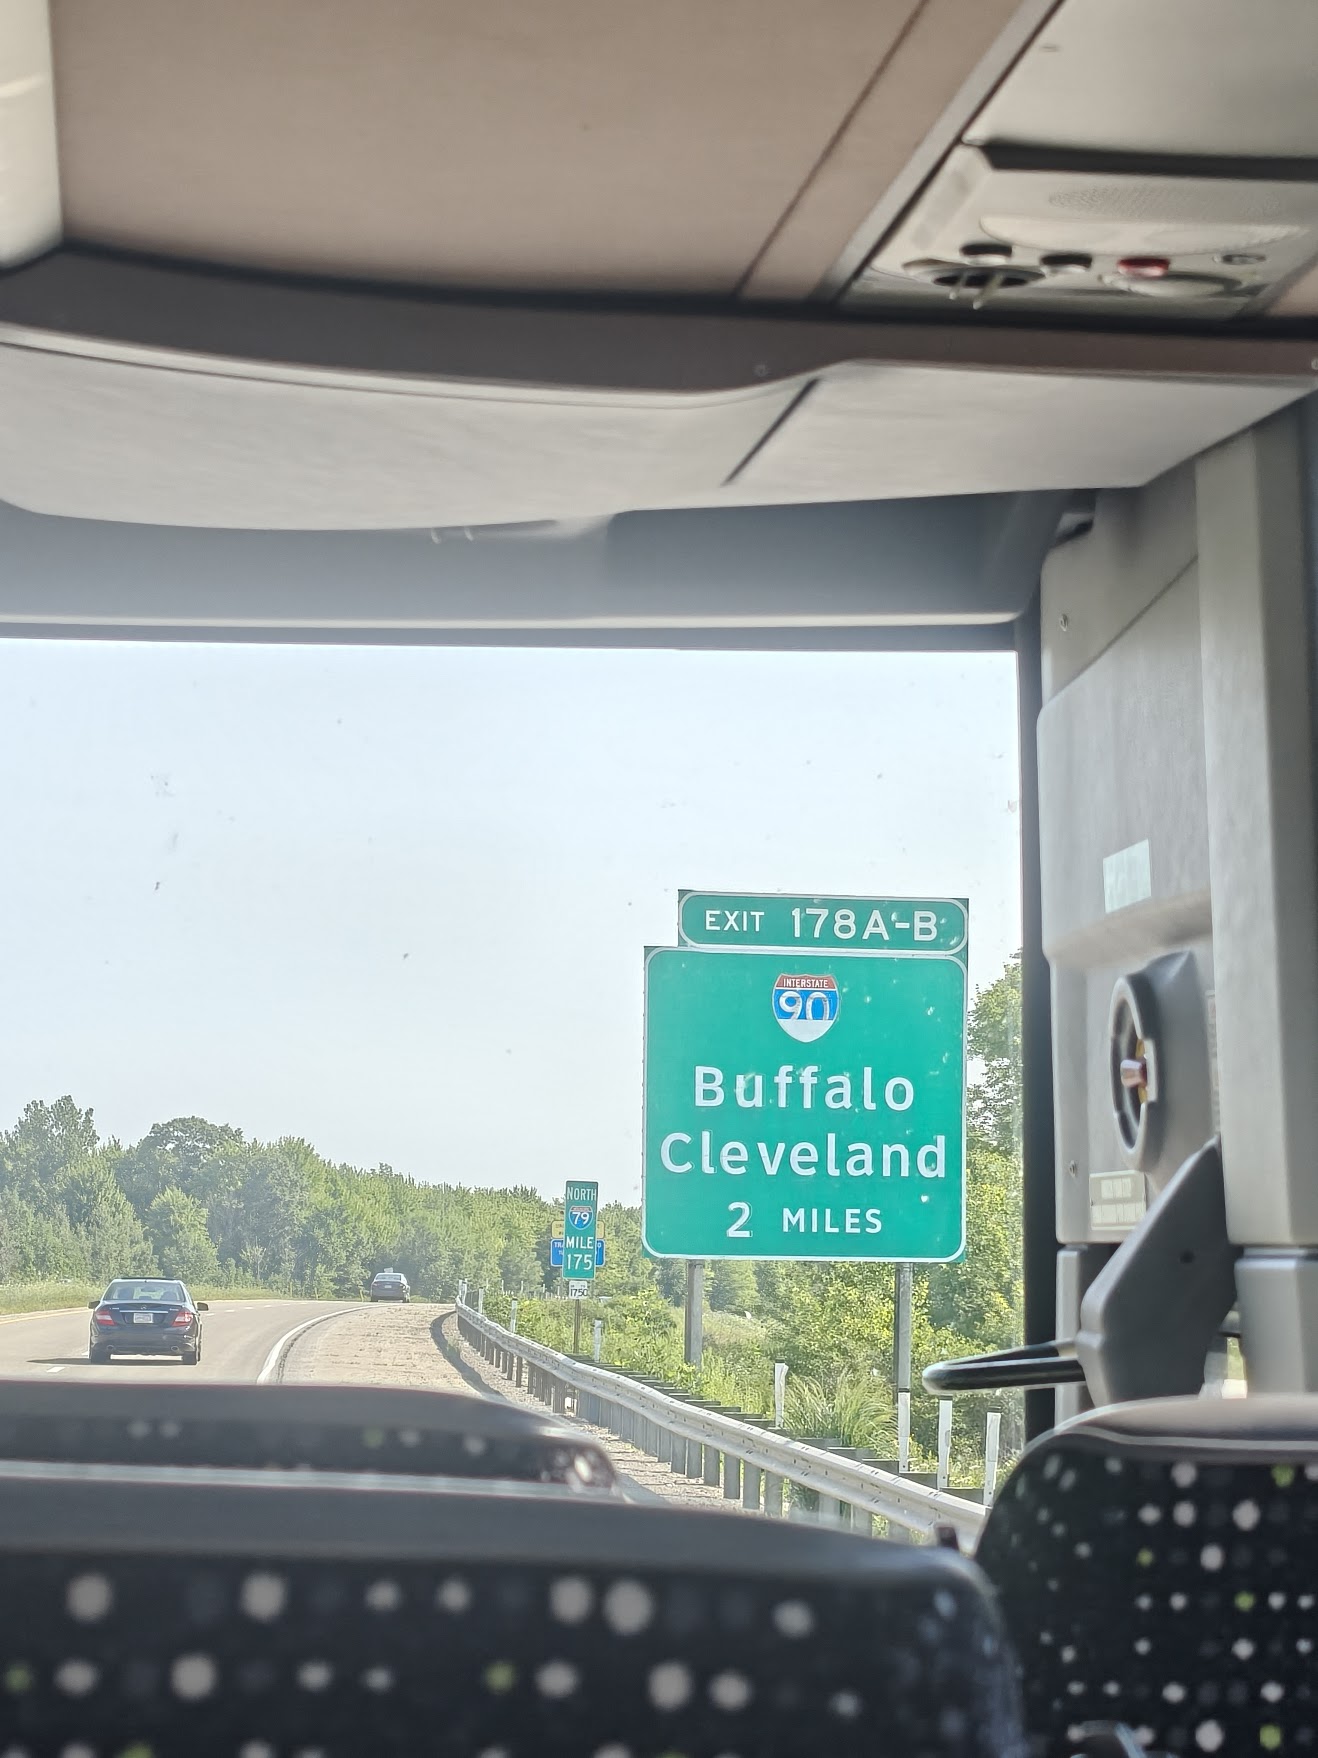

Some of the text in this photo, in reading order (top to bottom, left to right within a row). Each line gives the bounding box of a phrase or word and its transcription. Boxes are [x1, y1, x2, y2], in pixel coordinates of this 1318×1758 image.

[705, 908, 938, 941] EXIT 178A-B
[783, 978, 829, 989] INTERSTATE
[779, 990, 831, 1021] 90
[694, 1065, 914, 1111] Buffalo
[660, 1130, 946, 1178] Cleveland
[567, 1187, 597, 1201] NORTH
[572, 1211, 589, 1225] 79
[726, 1201, 882, 1237] 2 MILES
[566, 1236, 594, 1249] MILE
[567, 1254, 593, 1270] 175
